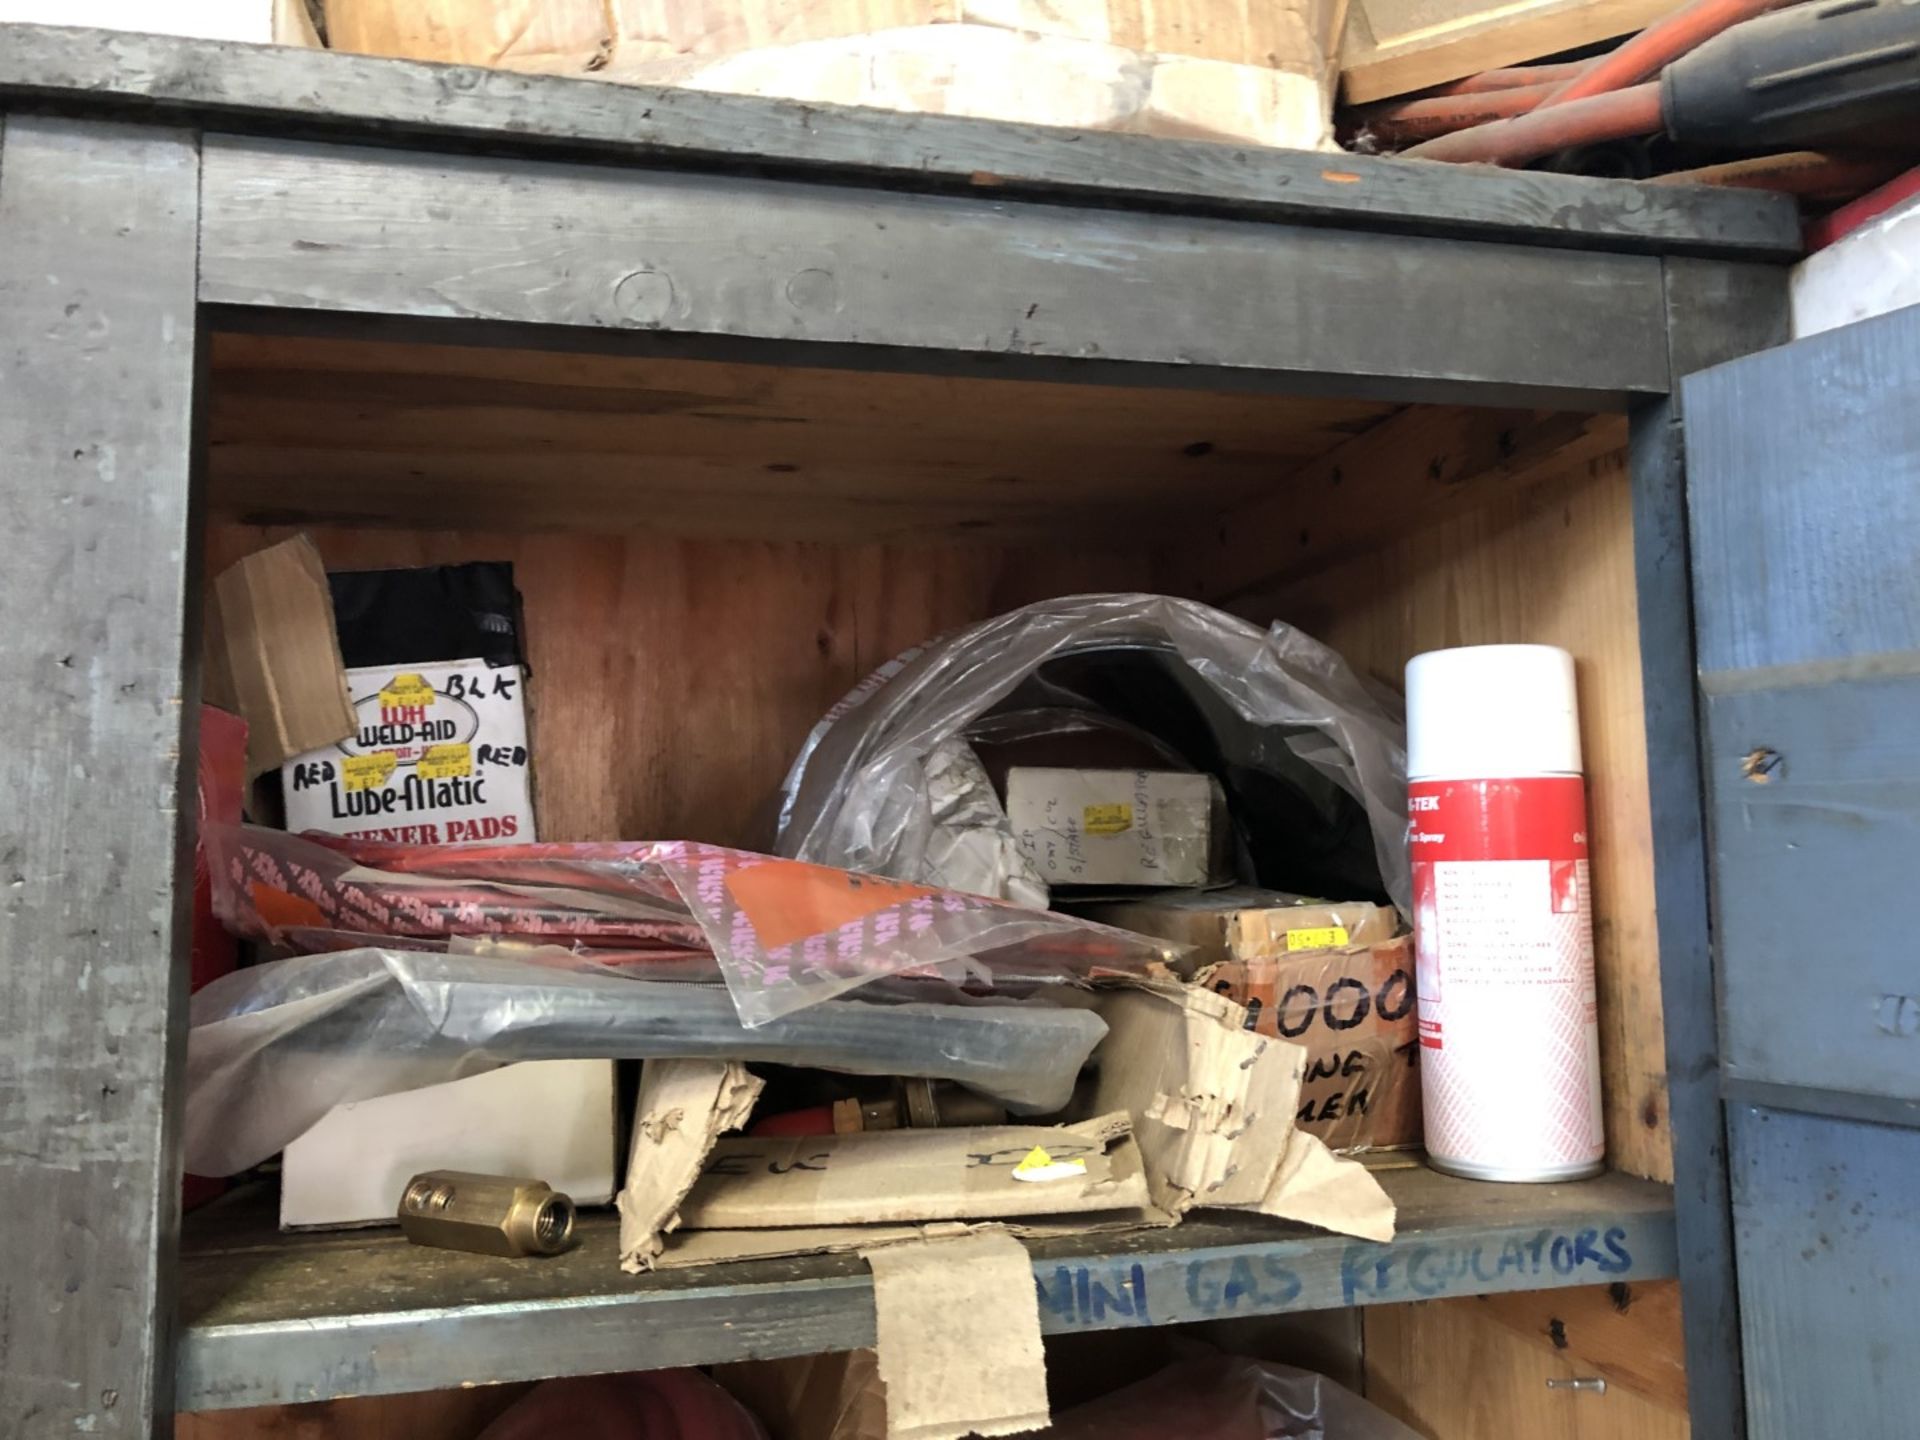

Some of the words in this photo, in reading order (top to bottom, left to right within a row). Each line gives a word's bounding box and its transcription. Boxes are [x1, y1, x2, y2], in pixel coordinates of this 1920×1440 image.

[446, 674, 517, 701] BLK
[356, 720, 457, 748] WELD-AID
[478, 744, 527, 767] RED
[293, 761, 336, 792] RED
[331, 774, 487, 819] Lube-Matic
[445, 815, 518, 844] PADS
[1186, 1254, 1303, 1312] GAS
[1341, 1226, 1633, 1305] REGULATORS
